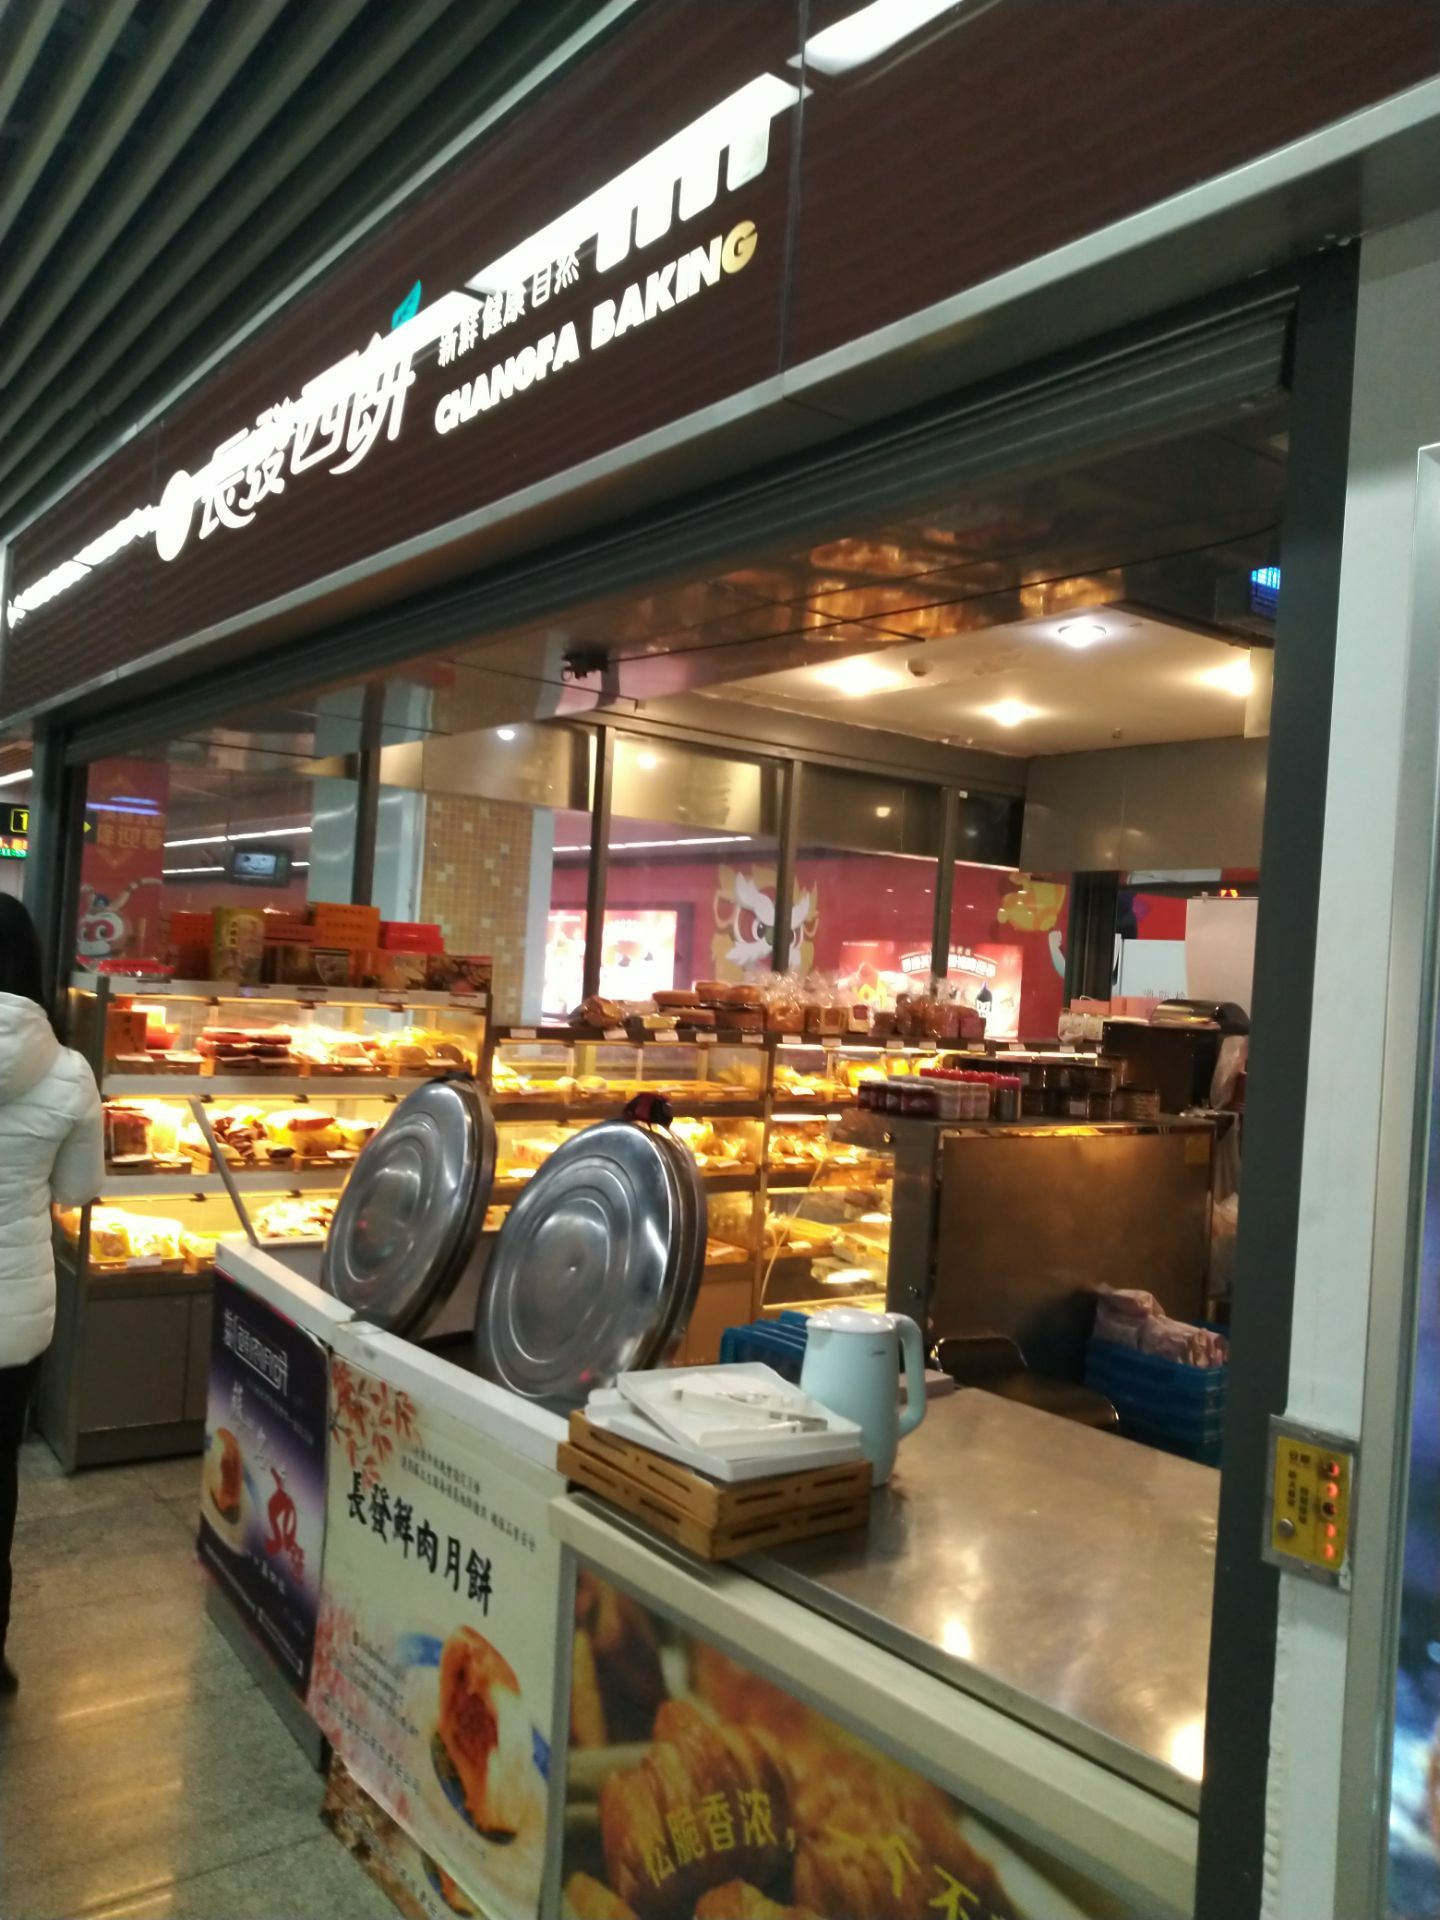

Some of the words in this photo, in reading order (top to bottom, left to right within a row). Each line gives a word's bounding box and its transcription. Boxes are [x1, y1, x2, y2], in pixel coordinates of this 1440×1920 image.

[591, 220, 758, 350] BAKING
[347, 1471, 493, 1618] 長發鮮肉月餅
